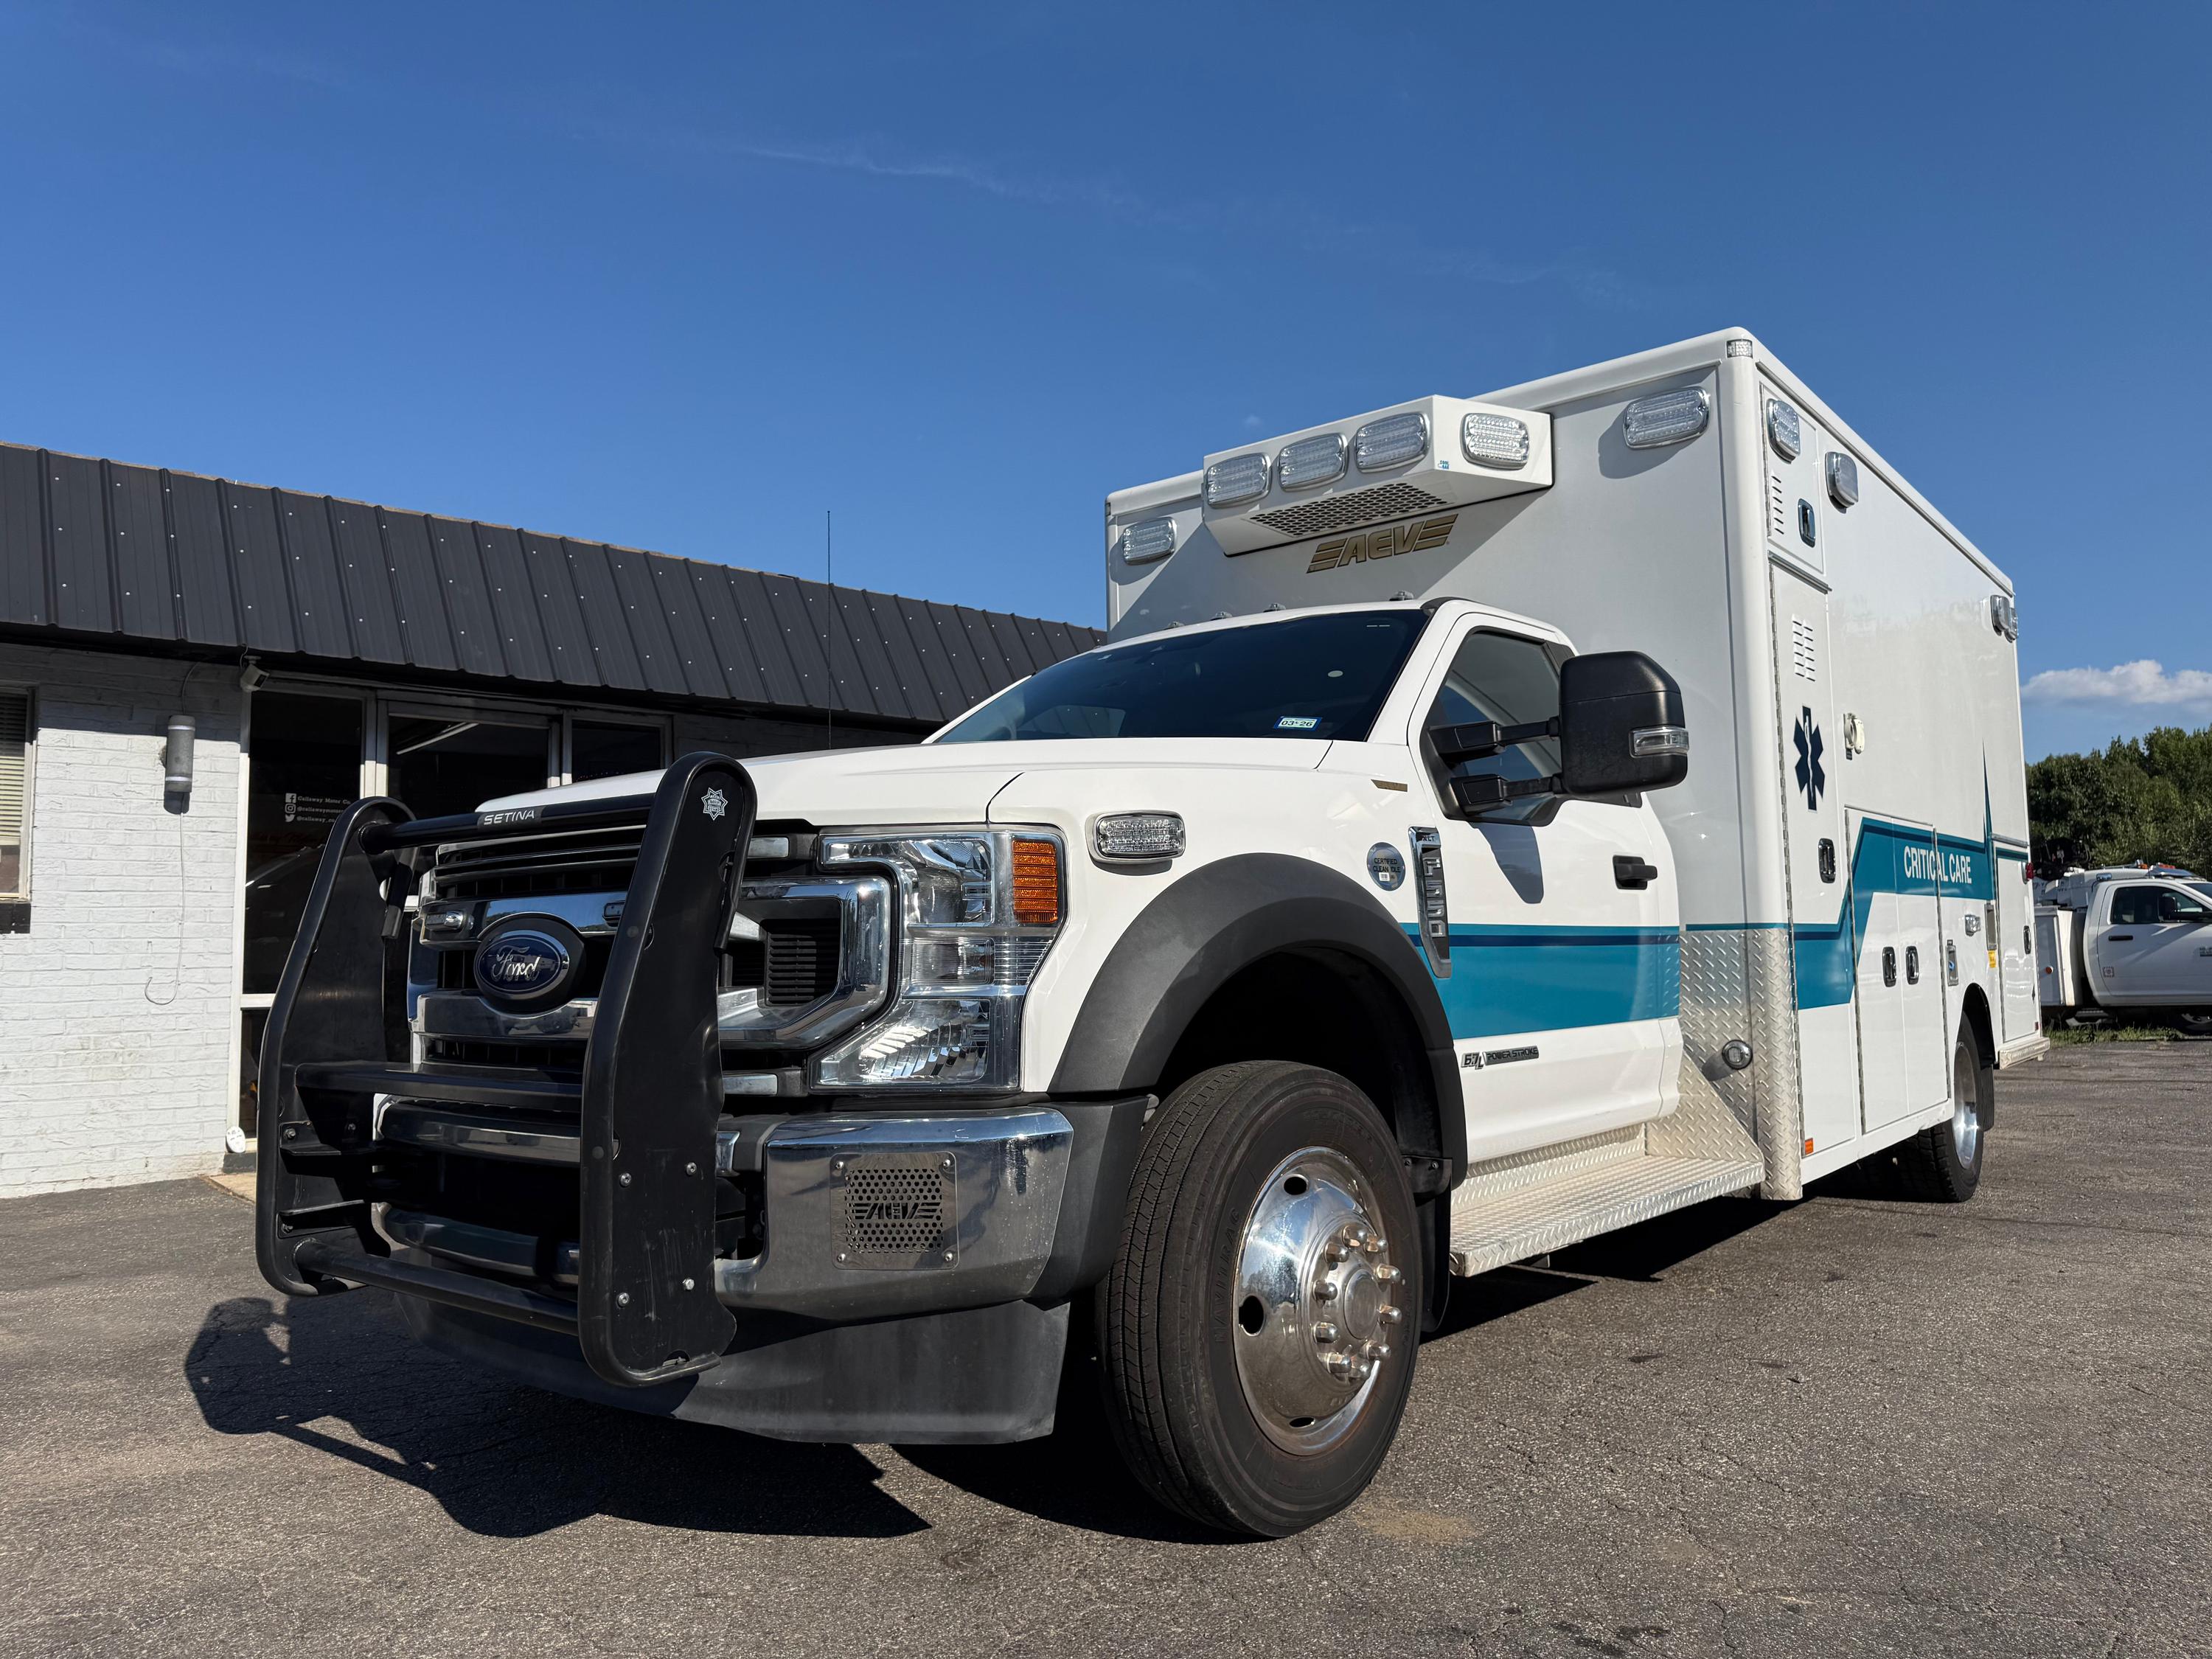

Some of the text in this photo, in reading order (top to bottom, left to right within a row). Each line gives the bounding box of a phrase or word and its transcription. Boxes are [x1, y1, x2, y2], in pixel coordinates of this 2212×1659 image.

[484, 810, 535, 825] SETINA
[1904, 846, 1972, 883] CRITICAL CARE
[491, 945, 542, 981] Ford
[1486, 1051, 1511, 1061] POWER
[1511, 1046, 1539, 1058] STROKE
